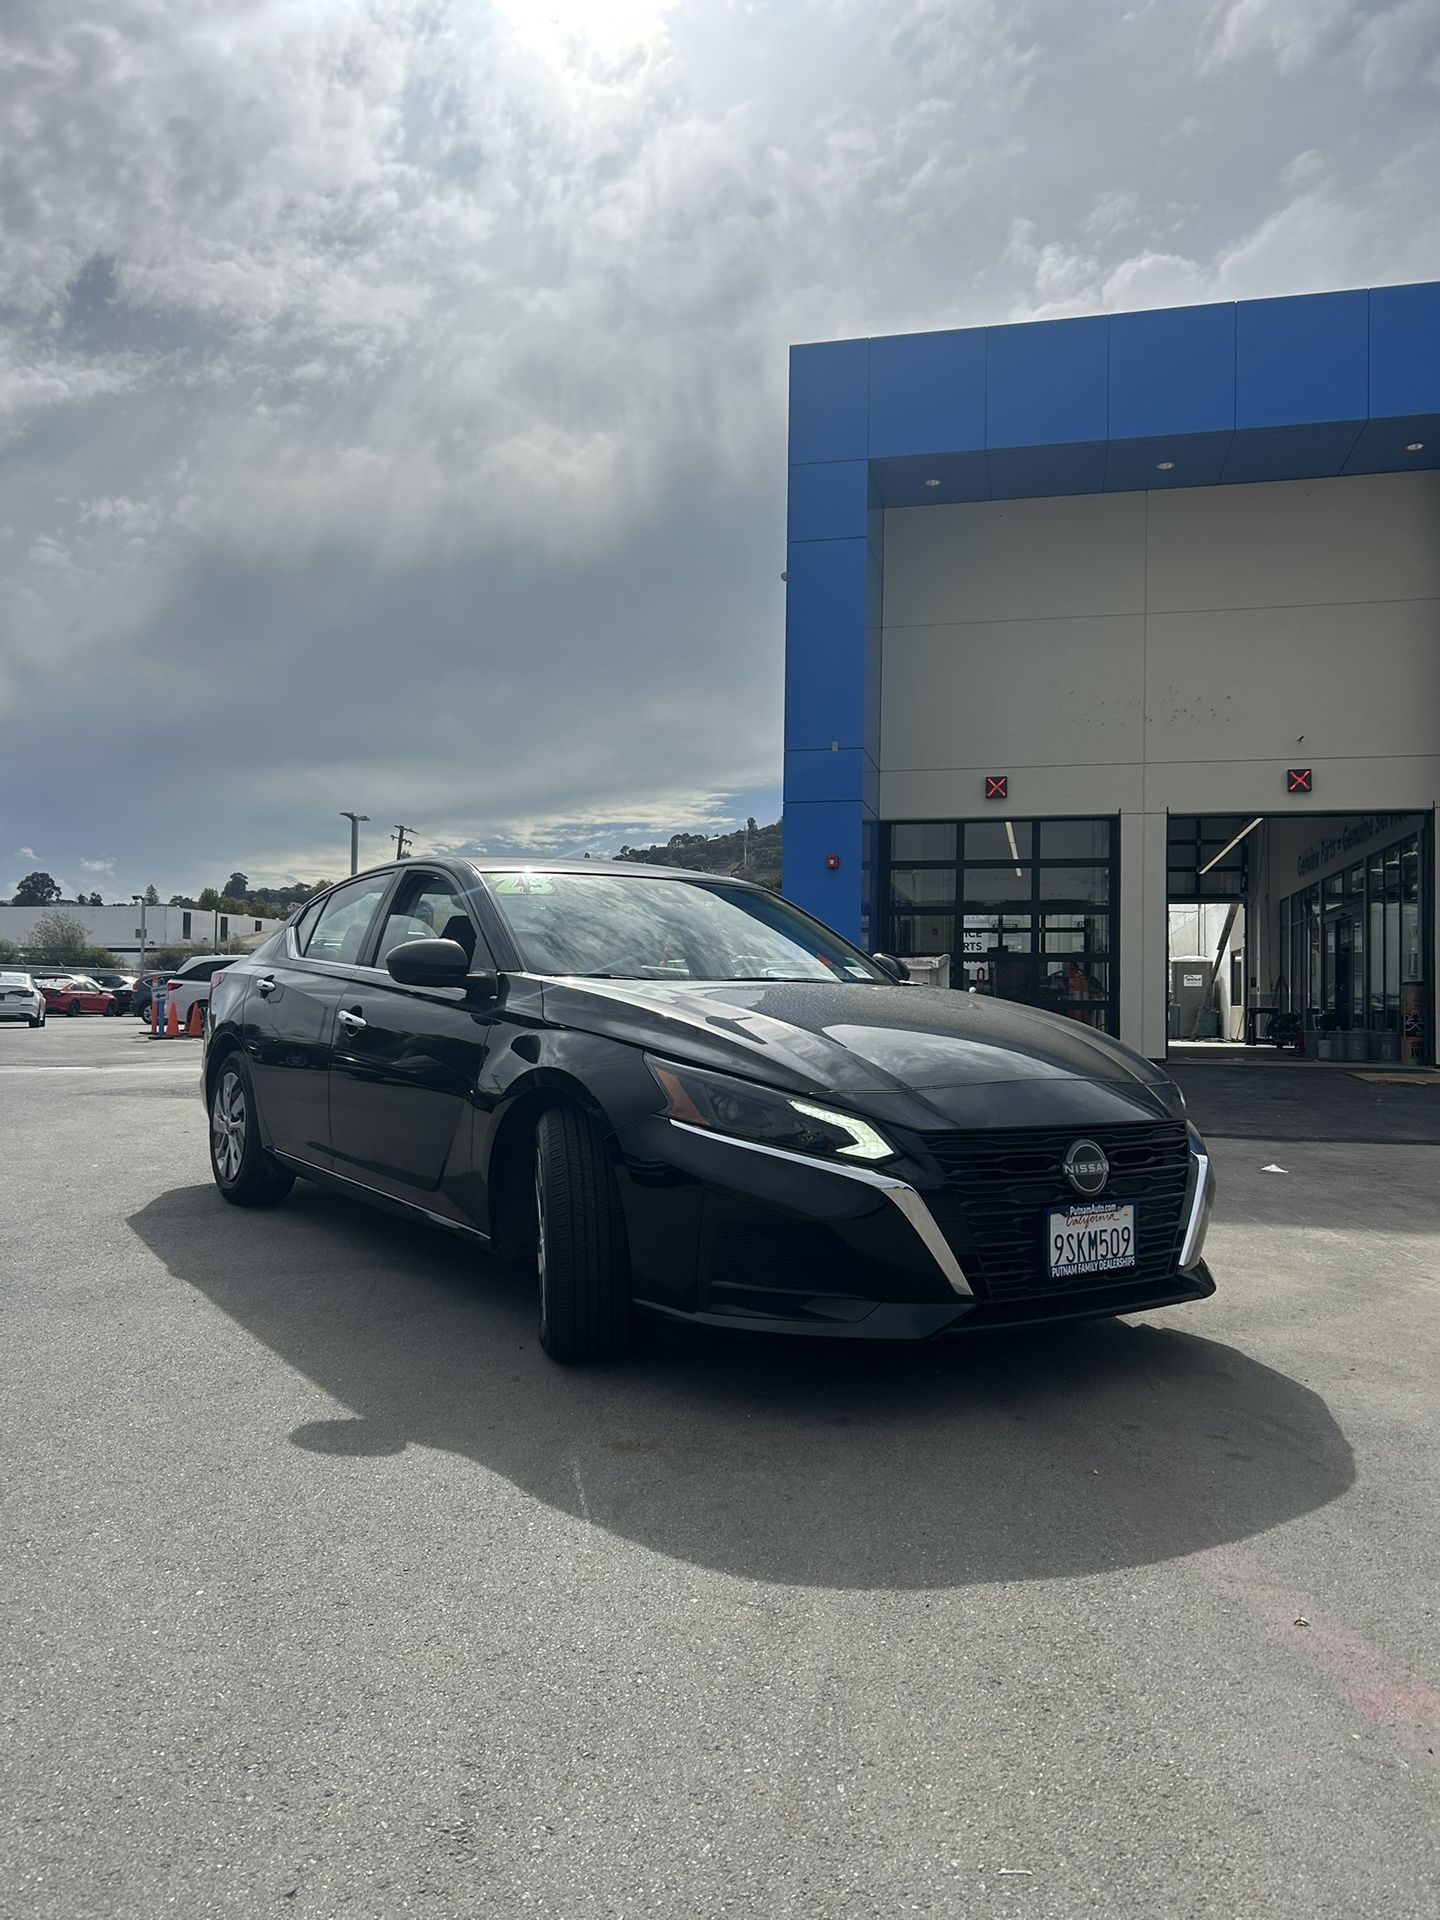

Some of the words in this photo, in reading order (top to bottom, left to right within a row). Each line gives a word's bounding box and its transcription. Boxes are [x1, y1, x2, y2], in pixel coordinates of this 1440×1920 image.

[1064, 1162, 1109, 1175] NISSAN
[1070, 1204, 1117, 1216] PutnamAuto.com
[1065, 1212, 1120, 1229] California
[1054, 1226, 1131, 1265] 9SKM509
[1052, 1264, 1078, 1278] PUTNAM
[1078, 1261, 1099, 1274] FAMILY
[1099, 1256, 1136, 1271] DEALERSHIPS
